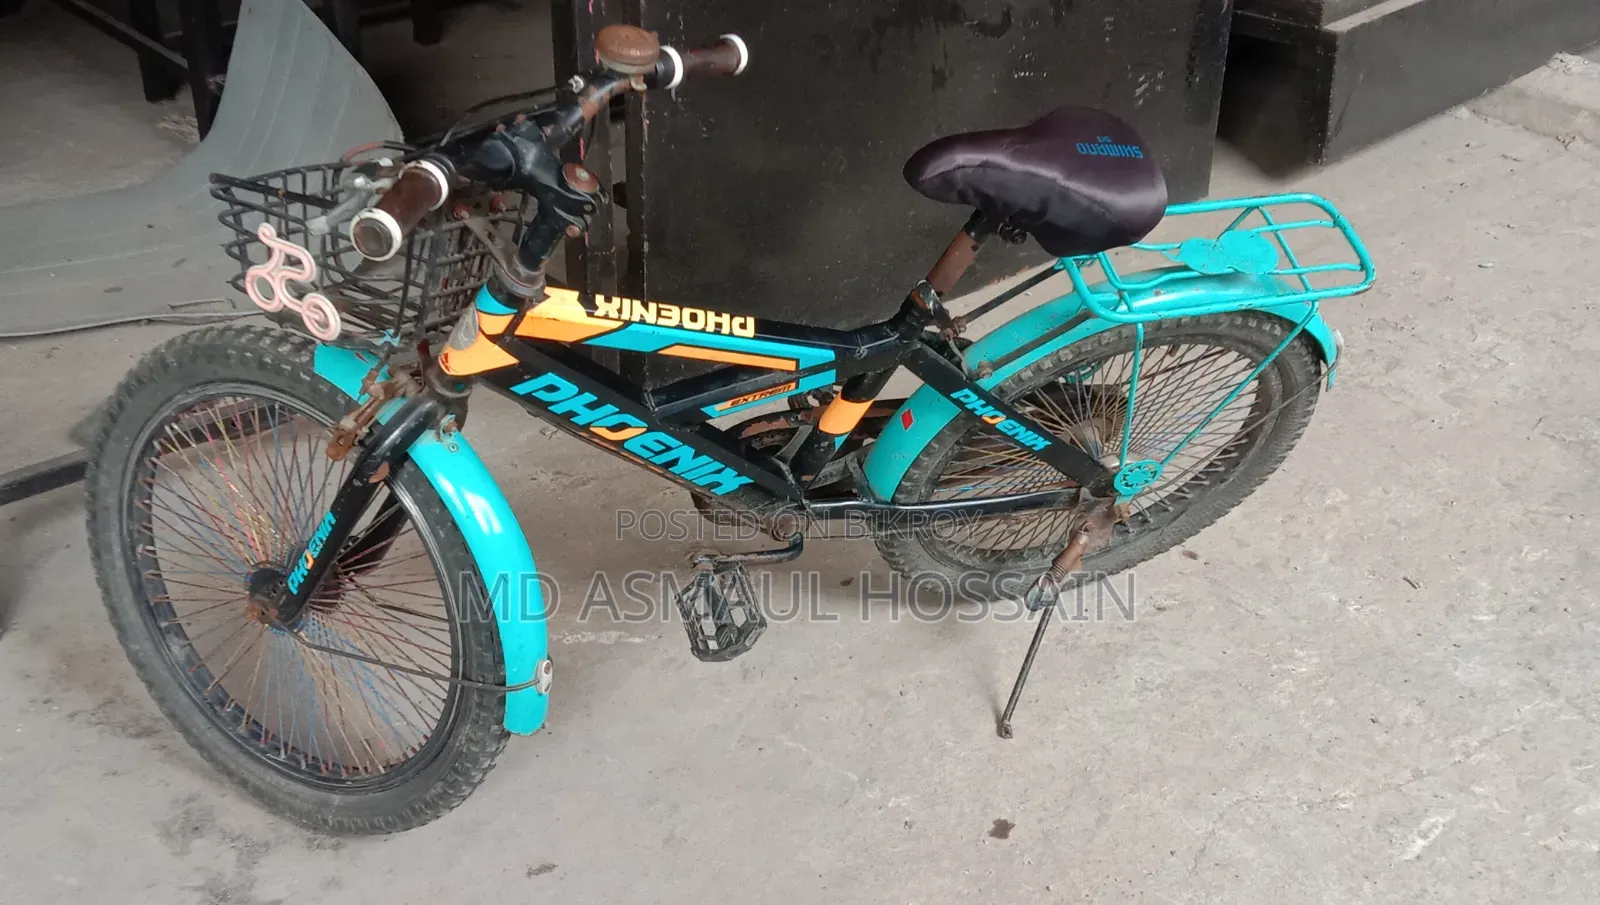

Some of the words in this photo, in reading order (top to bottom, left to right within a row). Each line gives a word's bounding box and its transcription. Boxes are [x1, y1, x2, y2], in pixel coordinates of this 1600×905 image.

[1076, 142, 1144, 159] SHIMANO
[593, 294, 755, 338] PHOENIX
[509, 372, 755, 496] PHOENIX
[950, 388, 1052, 452] PHOENIX
[287, 510, 337, 595] PHOENIX
